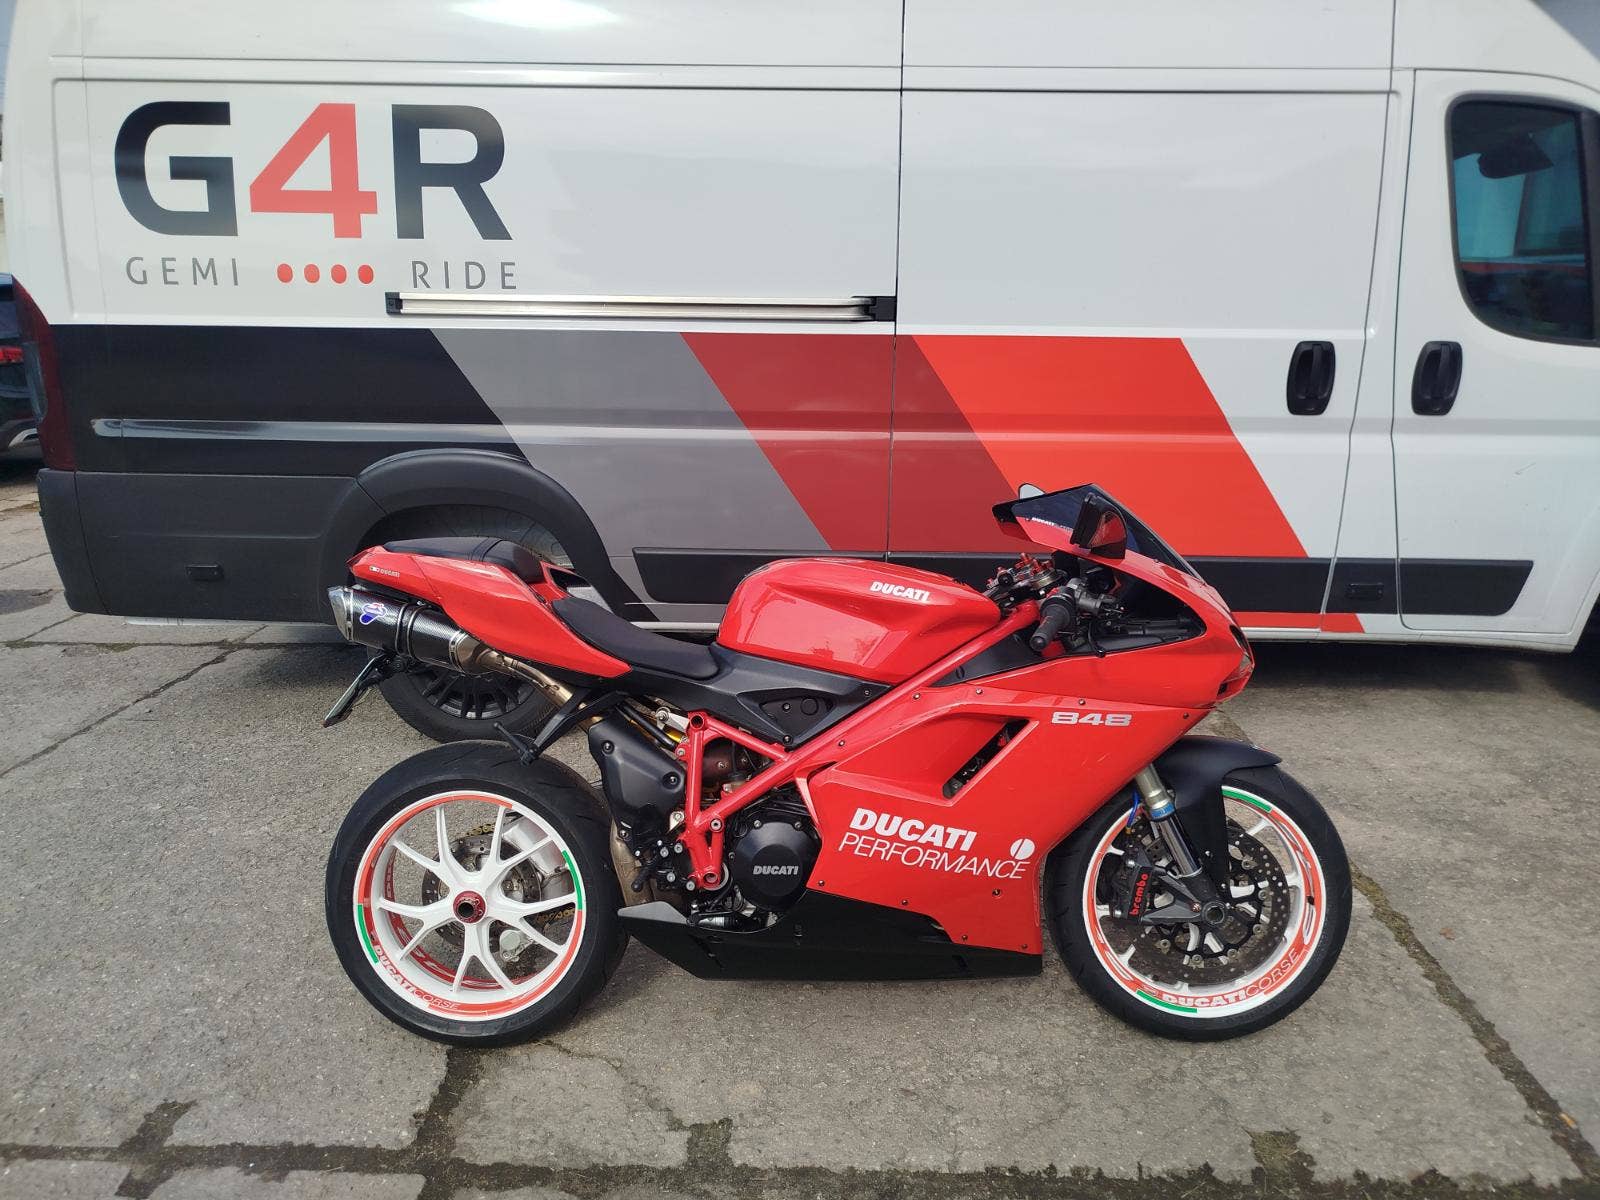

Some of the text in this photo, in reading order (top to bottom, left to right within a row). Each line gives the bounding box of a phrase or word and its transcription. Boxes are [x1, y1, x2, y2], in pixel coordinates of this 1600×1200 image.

[114, 101, 513, 240] G4R
[126, 257, 517, 290] GEMI RIDE
[870, 581, 930, 602] DUCATI
[1051, 711, 1133, 727] 848
[849, 807, 977, 851] DUCATI
[753, 865, 799, 875] DUCATI
[838, 832, 1031, 879] PERFORMANCE
[1129, 873, 1148, 916] brembo
